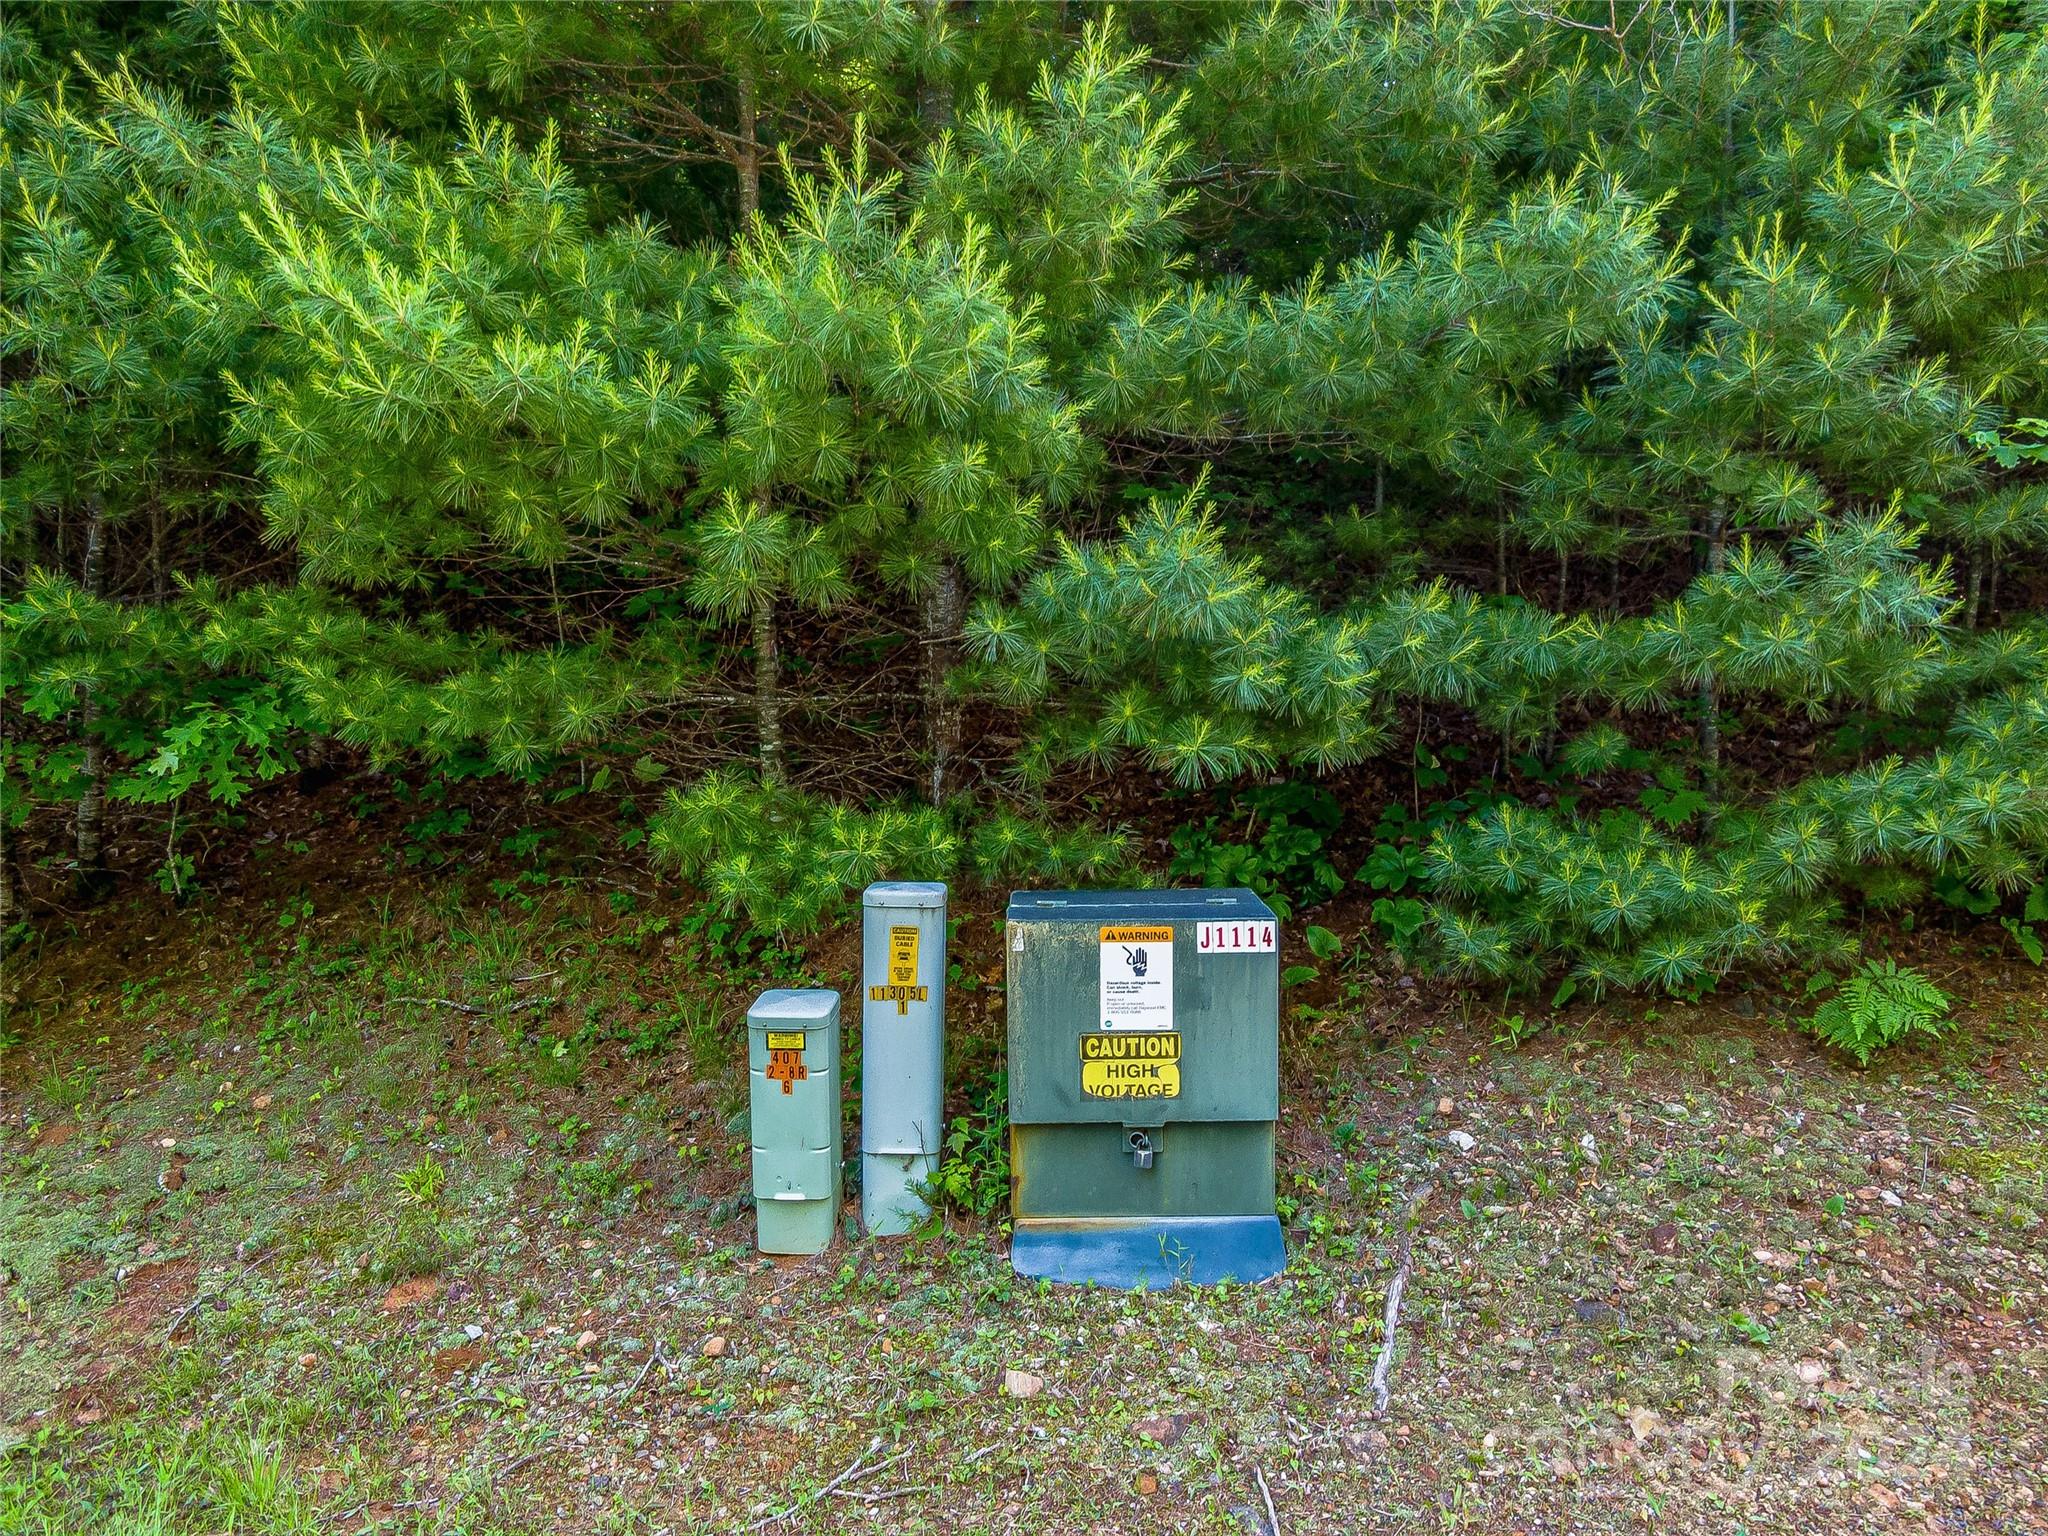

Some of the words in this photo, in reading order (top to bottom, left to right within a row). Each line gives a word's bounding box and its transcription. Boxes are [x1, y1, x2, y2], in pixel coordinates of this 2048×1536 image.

[1118, 931, 1169, 940] WARNING
[1200, 926, 1273, 948] J1114
[1086, 1037, 1175, 1057] CAUTION
[772, 1052, 799, 1064] 407
[1107, 1064, 1154, 1078] HIGH
[783, 1080, 790, 1094] 6
[1089, 1083, 1173, 1097] VOLTAGE
